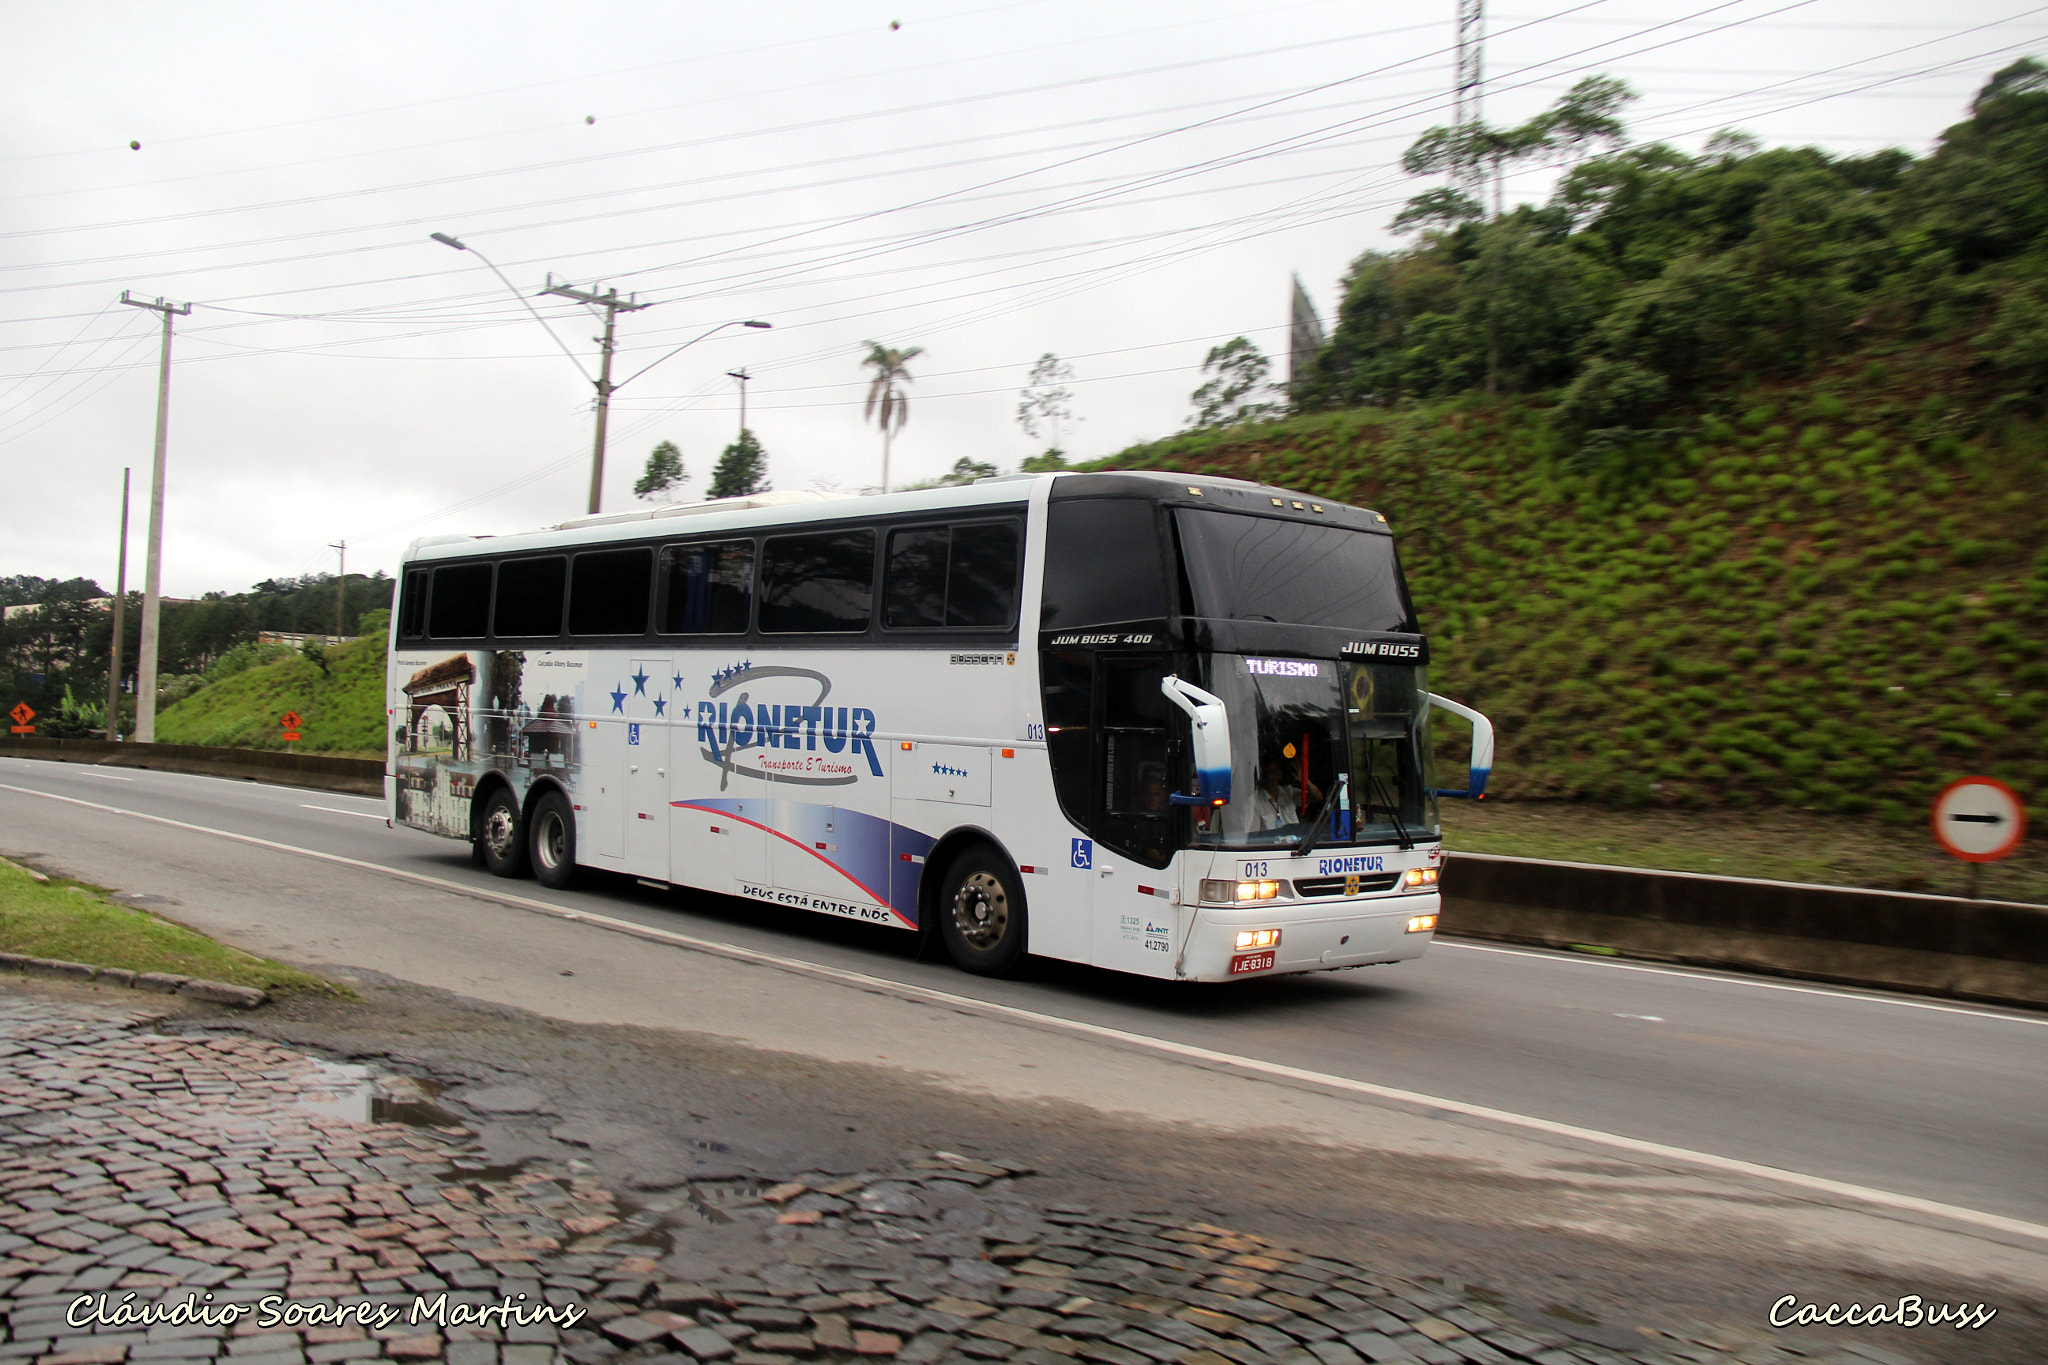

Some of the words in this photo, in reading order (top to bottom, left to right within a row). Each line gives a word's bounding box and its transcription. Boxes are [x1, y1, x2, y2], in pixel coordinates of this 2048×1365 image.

[1051, 635, 1080, 645] JUM
[1080, 634, 1119, 644] BUSS
[1122, 634, 1153, 644] 400
[1342, 641, 1377, 655] JUM
[1378, 644, 1420, 658] BUSS
[1246, 659, 1319, 677] TURISMO
[697, 701, 884, 777] RIONETUR
[1027, 723, 1044, 740] 013
[758, 754, 804, 772] Transporte
[806, 757, 813, 771] E
[815, 757, 853, 774] Turismo
[1245, 861, 1268, 878] 013
[1319, 856, 1384, 876] RIONETUR
[743, 885, 774, 900] DEUS
[777, 894, 808, 906] ESTÁ
[812, 899, 857, 916] ENTRE
[860, 907, 890, 922] NÓS
[1144, 939, 1170, 952] 41.2790
